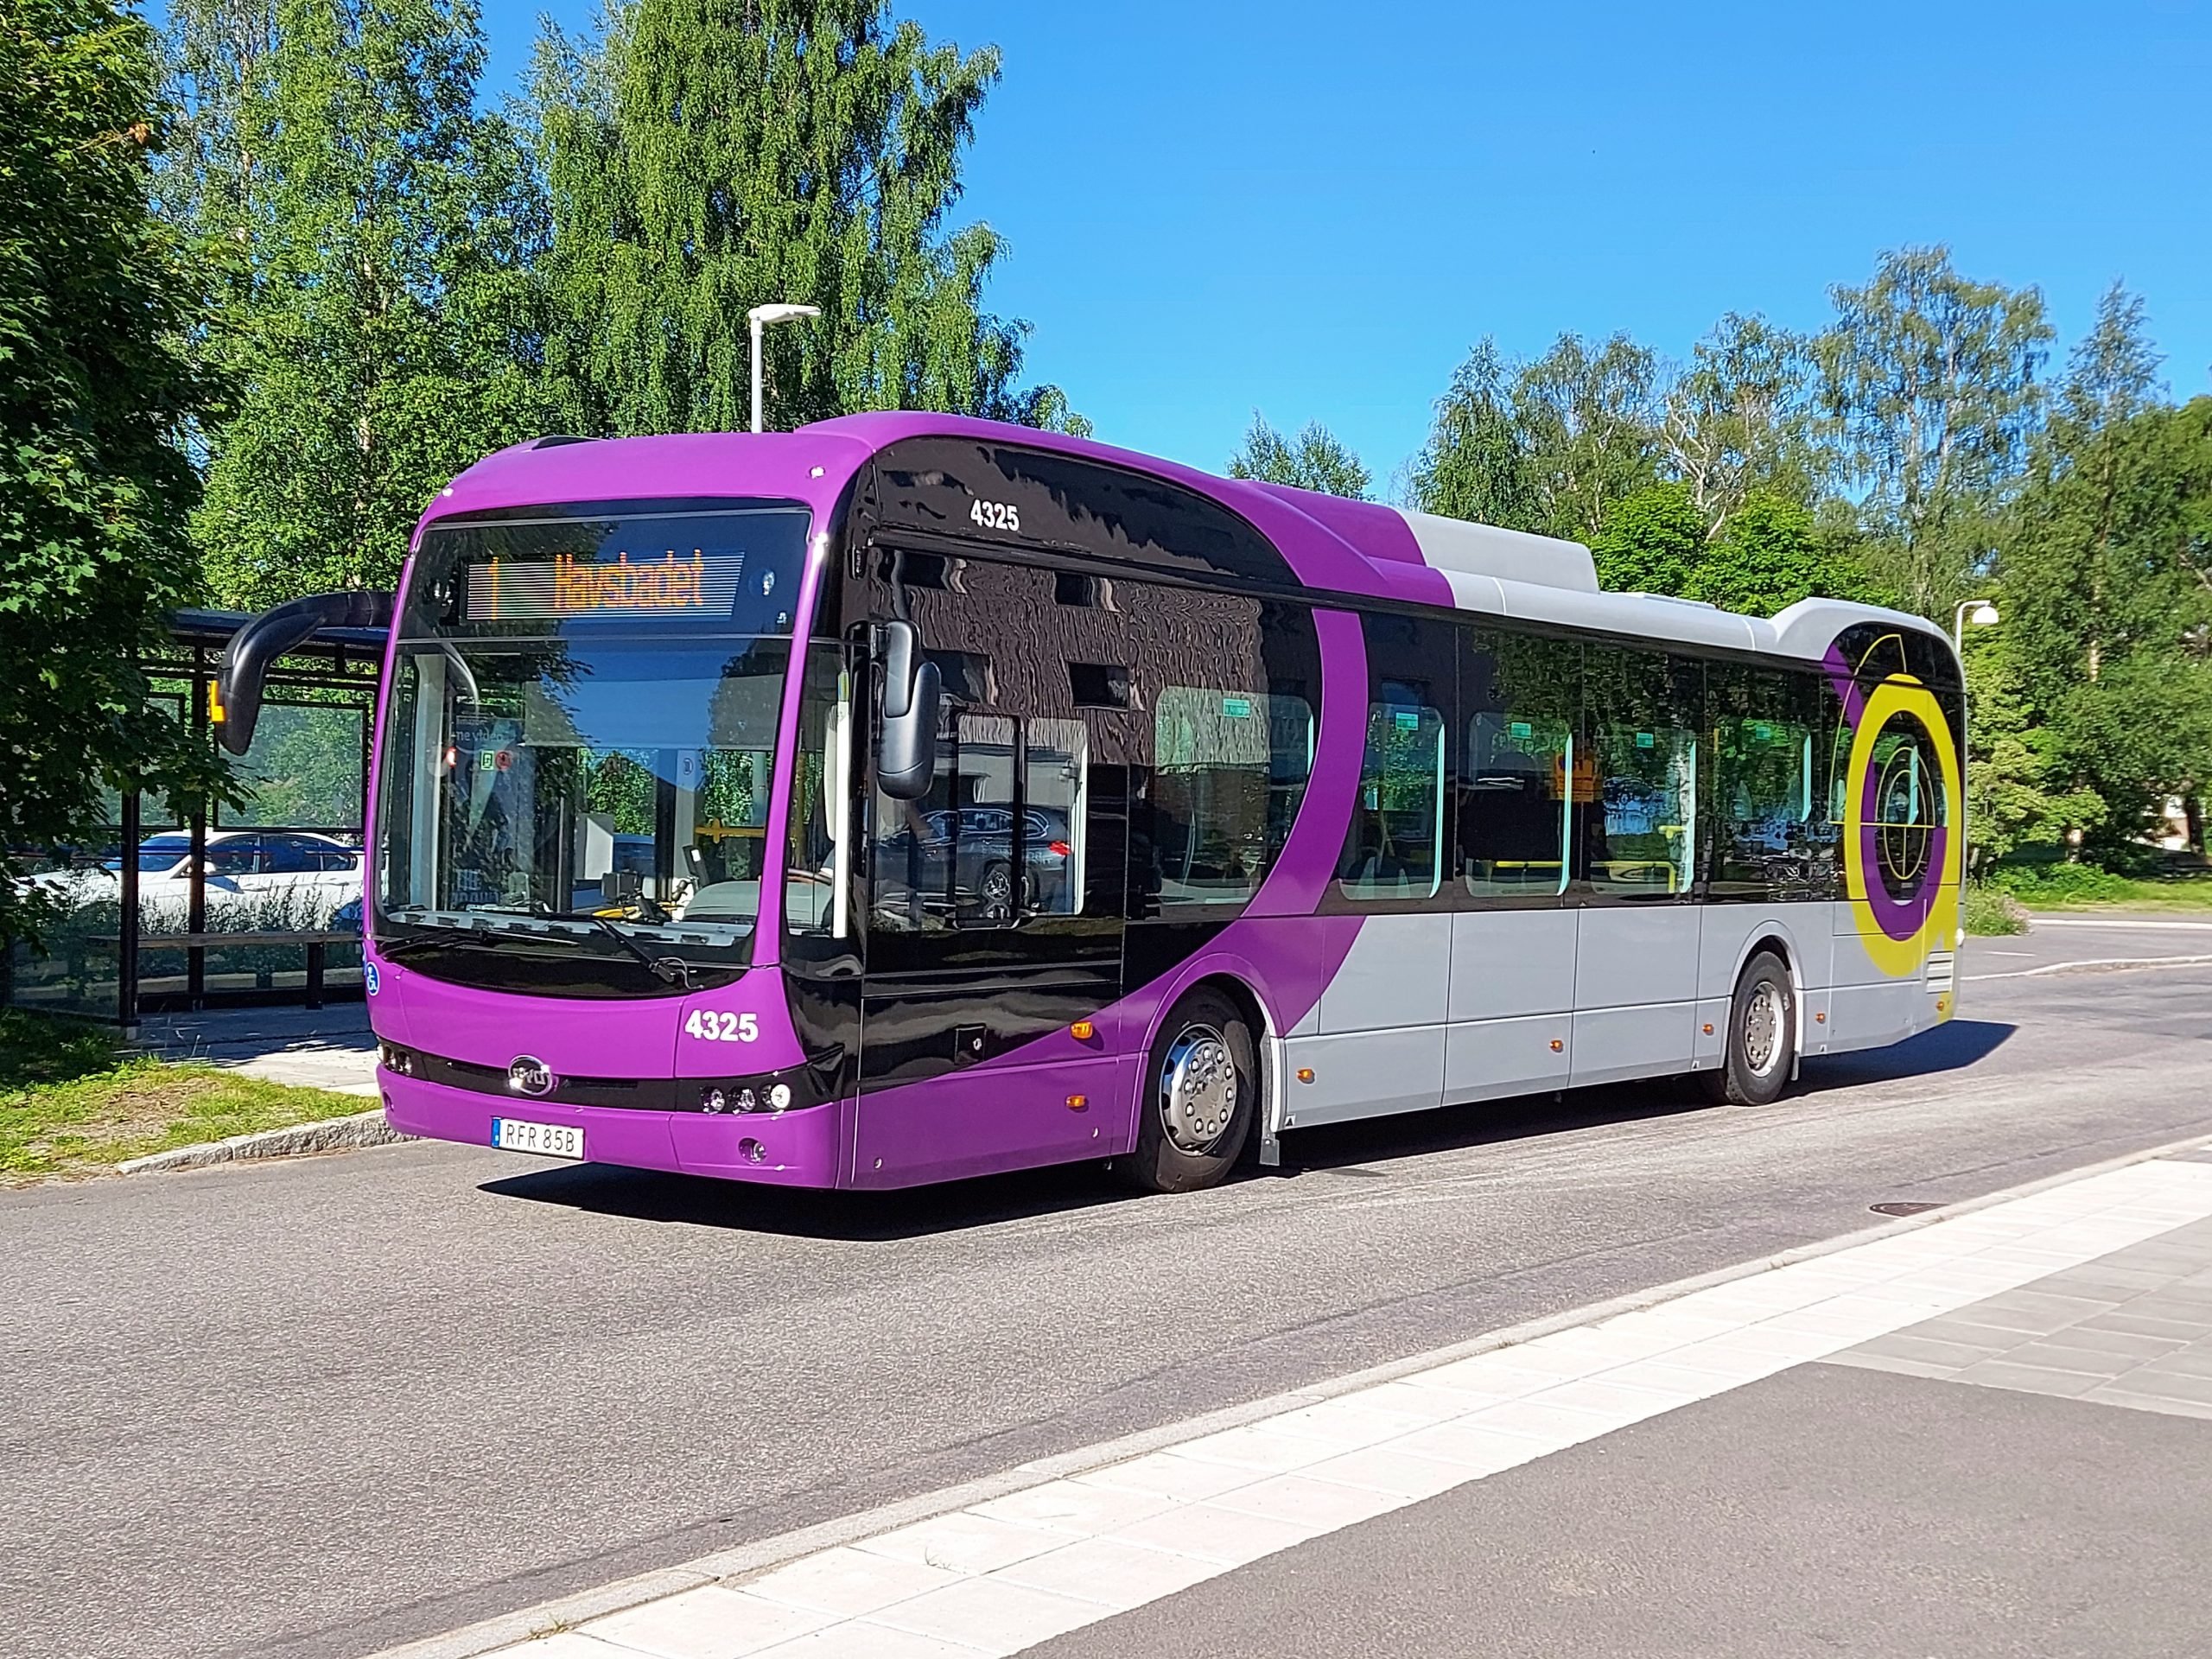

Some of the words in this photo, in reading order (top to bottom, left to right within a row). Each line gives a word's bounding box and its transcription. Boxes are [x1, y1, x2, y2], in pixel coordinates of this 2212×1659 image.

[969, 498, 1020, 532] 4325
[487, 556, 499, 621] 1
[553, 548, 705, 609] Havsbadet
[683, 1008, 760, 1043] 4325
[505, 1123, 537, 1148] RFR
[543, 1128, 575, 1153] 85B
